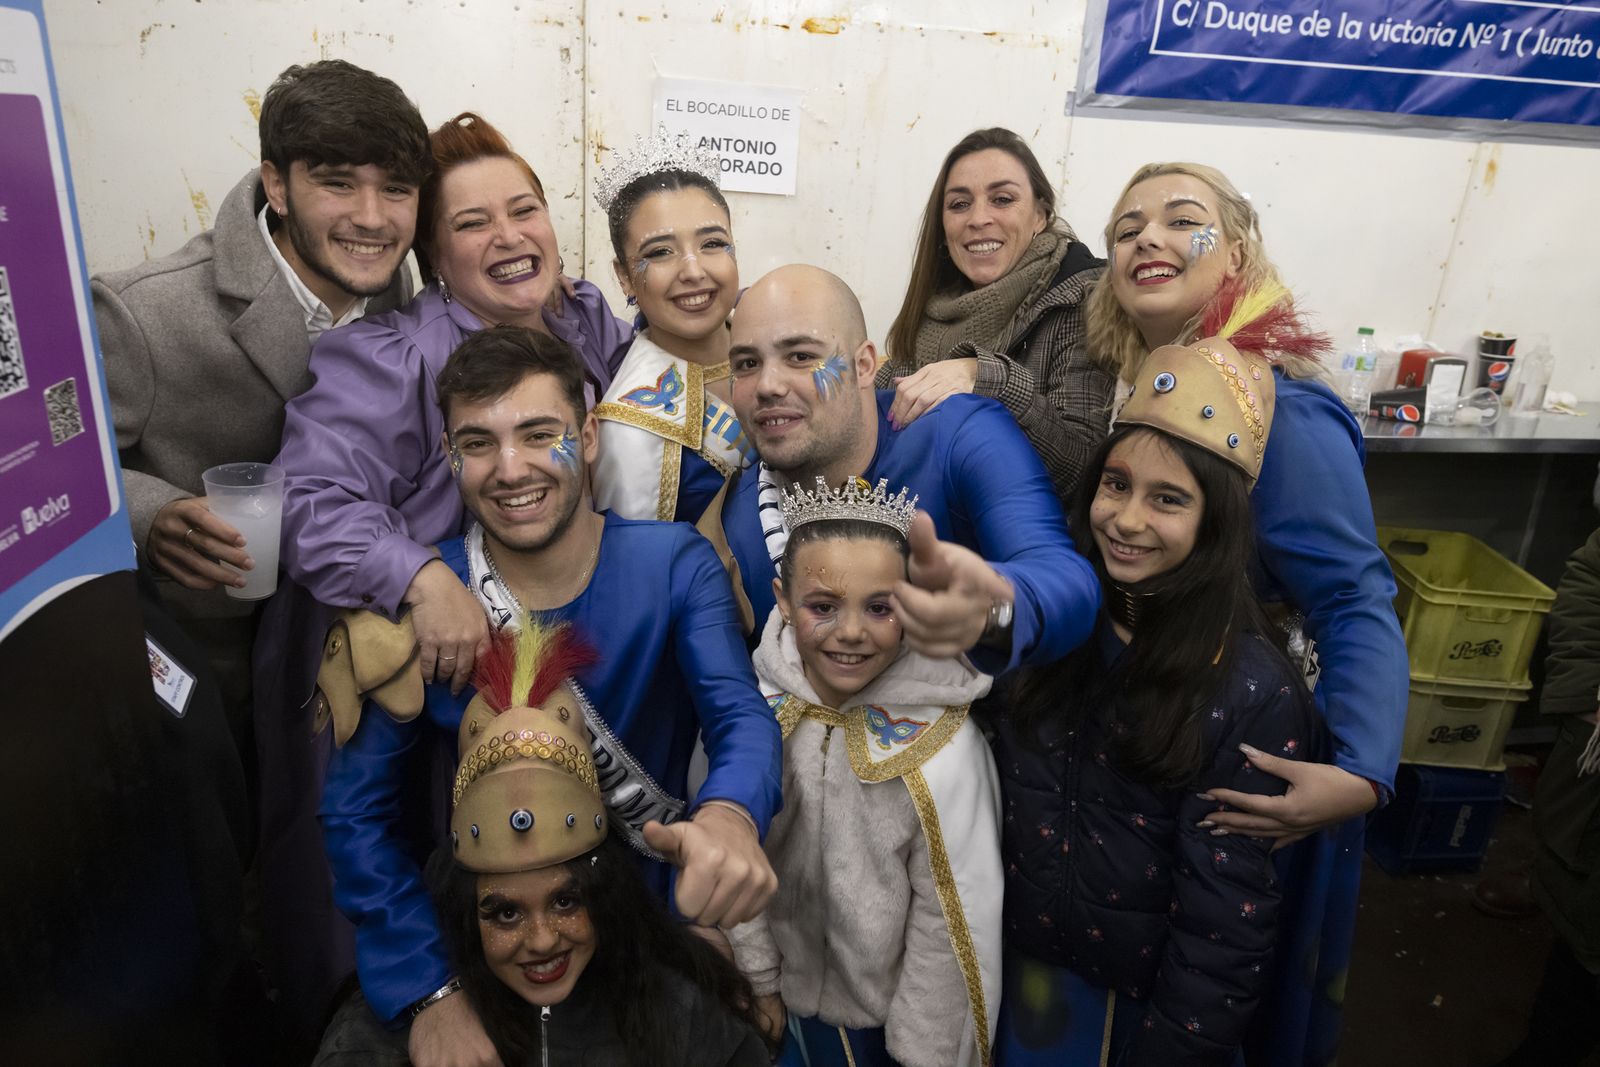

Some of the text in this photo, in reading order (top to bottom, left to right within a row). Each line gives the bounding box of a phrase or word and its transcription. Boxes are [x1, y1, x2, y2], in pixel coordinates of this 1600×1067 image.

[1204, 1, 1293, 37] Duque
[1299, 9, 1331, 37] de
[1337, 12, 1363, 39] la
[1369, 17, 1457, 47] victoria
[1458, 22, 1497, 48] Nº
[1500, 28, 1512, 51] 1
[666, 98, 790, 121] EL BOCADILLO DE
[698, 136, 777, 156] ANTONIO
[719, 158, 782, 176] ORADO
